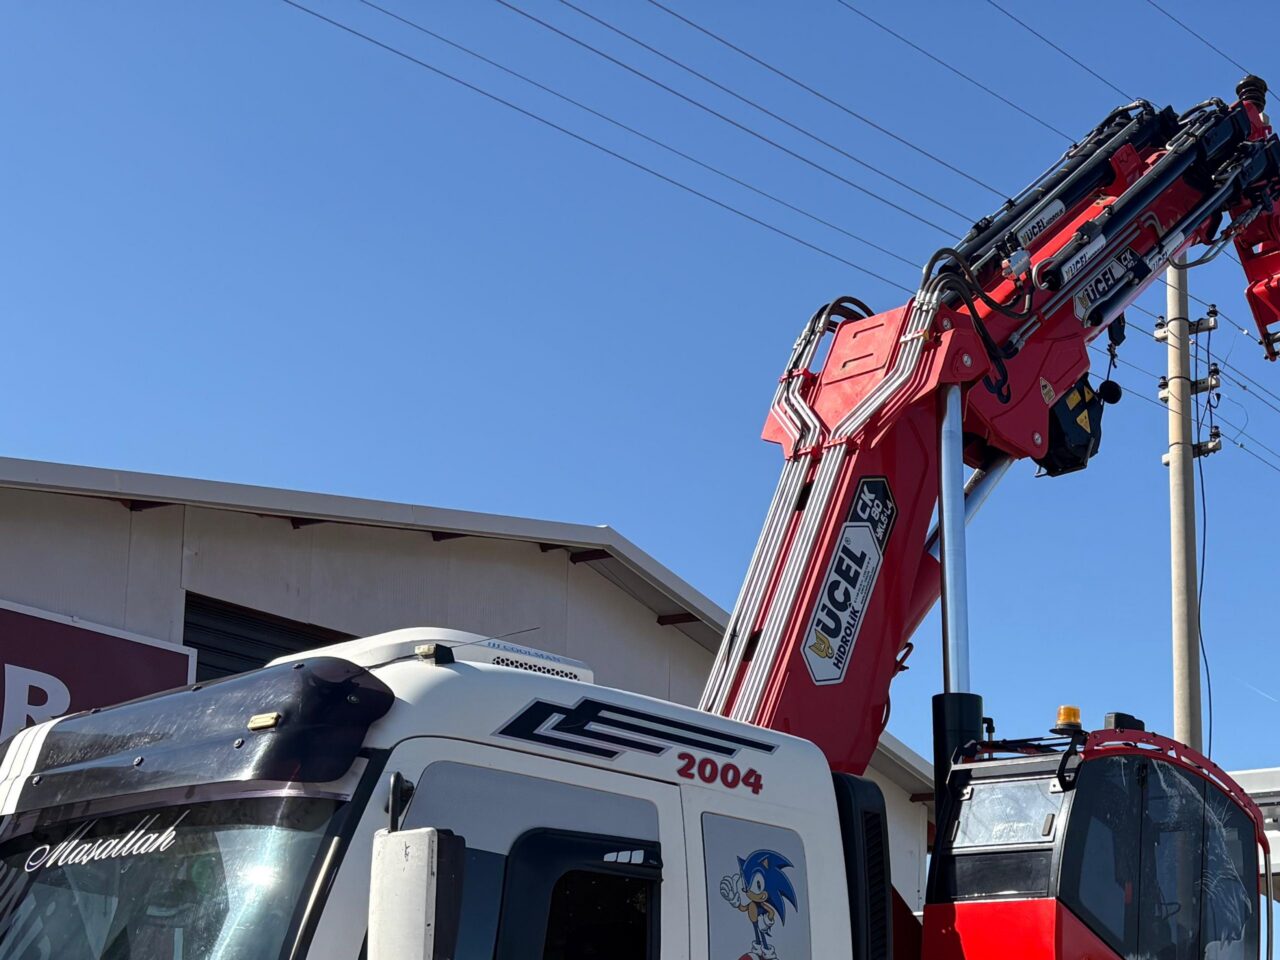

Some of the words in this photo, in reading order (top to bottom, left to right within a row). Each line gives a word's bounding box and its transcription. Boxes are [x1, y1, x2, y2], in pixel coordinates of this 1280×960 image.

[857, 484, 876, 520] CK
[871, 499, 883, 521] 80
[676, 752, 764, 795] 2004
